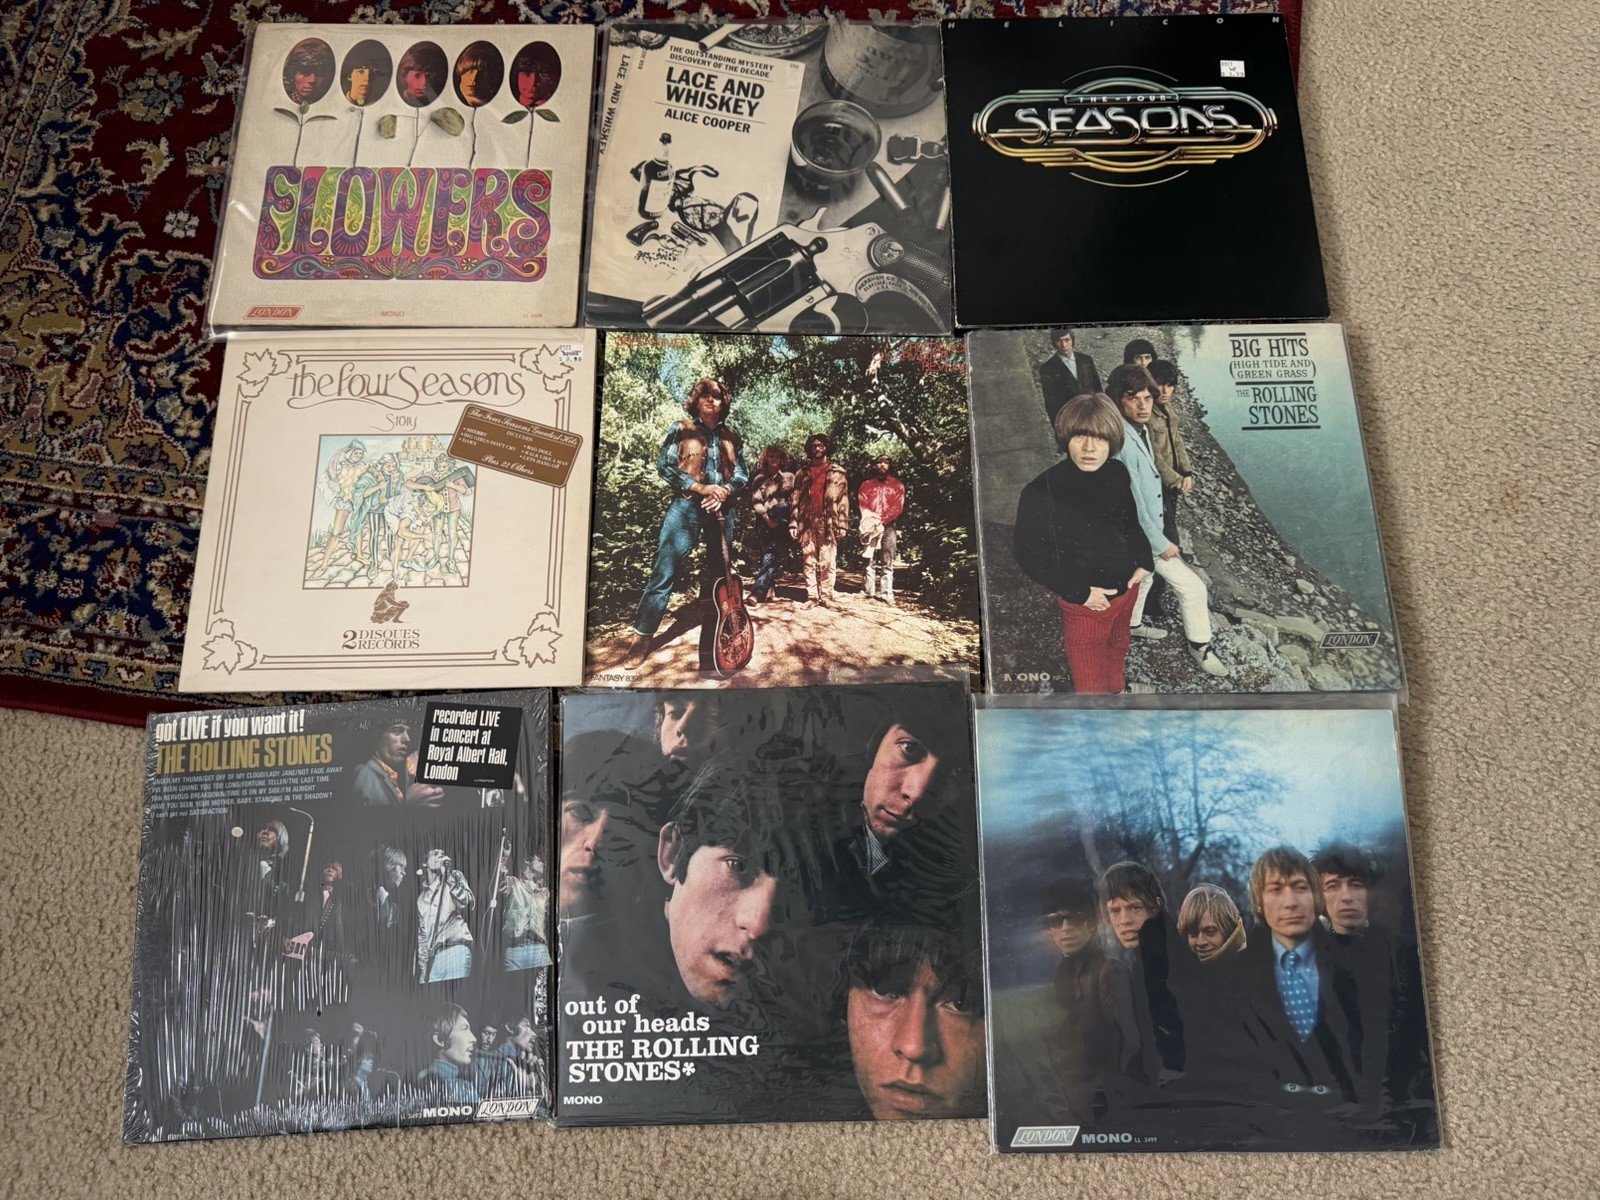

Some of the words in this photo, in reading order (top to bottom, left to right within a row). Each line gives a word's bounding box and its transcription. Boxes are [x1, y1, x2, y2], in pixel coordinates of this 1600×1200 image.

[617, 54, 630, 79] LACE
[669, 45, 684, 54] THE
[685, 47, 736, 64] OUTSTANDING
[738, 59, 774, 72] MYSTERY
[670, 53, 712, 66] DISCOVERY
[724, 64, 738, 72] THE
[740, 66, 770, 78] DECADE
[610, 82, 622, 104] AND
[666, 66, 718, 91] LACE
[722, 78, 765, 100] AND
[666, 84, 760, 117] WHISKEY
[600, 107, 616, 154] WHISKEY
[664, 108, 700, 124] ALICE
[702, 116, 752, 134] COOPER
[1014, 104, 1241, 146] SEASONS
[253, 166, 553, 259] FLOWERS
[248, 307, 296, 317] LONDON
[1229, 338, 1262, 358] BIG
[1266, 338, 1309, 358] HITS
[1262, 360, 1288, 368] TIDE
[1290, 360, 1311, 368] AND
[1236, 370, 1272, 379] GREEN
[398, 366, 526, 404] Seasons
[1236, 390, 1250, 398] THE
[1251, 386, 1318, 404] ROLLING
[1248, 404, 1318, 424] STONES
[462, 438, 477, 446] DAWN
[506, 430, 533, 442] INCLUDES
[482, 453, 499, 466] Plus
[510, 462, 534, 475] Others
[524, 450, 538, 458] WALK
[342, 629, 358, 650] 2
[359, 628, 420, 640] DISQUES
[358, 639, 420, 650] RECORDS
[1325, 634, 1374, 647] LONDON
[156, 719, 177, 743] got
[180, 716, 209, 742] LIVE
[211, 714, 222, 739] if
[224, 717, 250, 738] you
[250, 713, 286, 737] want
[288, 709, 306, 734] it!
[432, 708, 478, 726] recorded
[479, 710, 502, 728] LIVE
[430, 726, 440, 742] in
[442, 728, 480, 745] concert
[480, 729, 492, 746] at
[156, 743, 186, 776] THE
[189, 738, 260, 773] ROLLING
[264, 732, 333, 770] STONES
[426, 744, 455, 763] Royal
[456, 745, 486, 764] Albert
[488, 747, 508, 766] Hall,
[172, 776, 182, 784] MY
[216, 772, 227, 781] OFF
[228, 772, 236, 780] OF
[236, 771, 246, 780] MY
[310, 766, 325, 774] FADE
[326, 766, 344, 774] AWAY
[424, 762, 460, 781] London
[164, 792, 189, 802] NERVOUS
[258, 786, 268, 794] MY
[292, 784, 316, 793] ALRIGHT
[178, 784, 199, 792] LOVING
[200, 782, 212, 790] YOU
[300, 776, 314, 784] LAST
[316, 774, 330, 782] TIME
[166, 802, 179, 810] YOU
[292, 793, 303, 801] THE
[564, 995, 607, 1016] out
[614, 994, 641, 1014] of
[582, 1018, 626, 1035] our
[633, 1012, 710, 1034] heads
[566, 1039, 624, 1060] THE
[631, 1035, 760, 1059] ROLLING
[481, 1100, 533, 1116] LONDON
[563, 1096, 603, 1105] MONO
[422, 1105, 473, 1118] MONO
[1018, 1128, 1071, 1144] LONDON
[1081, 1133, 1132, 1144] MONO
